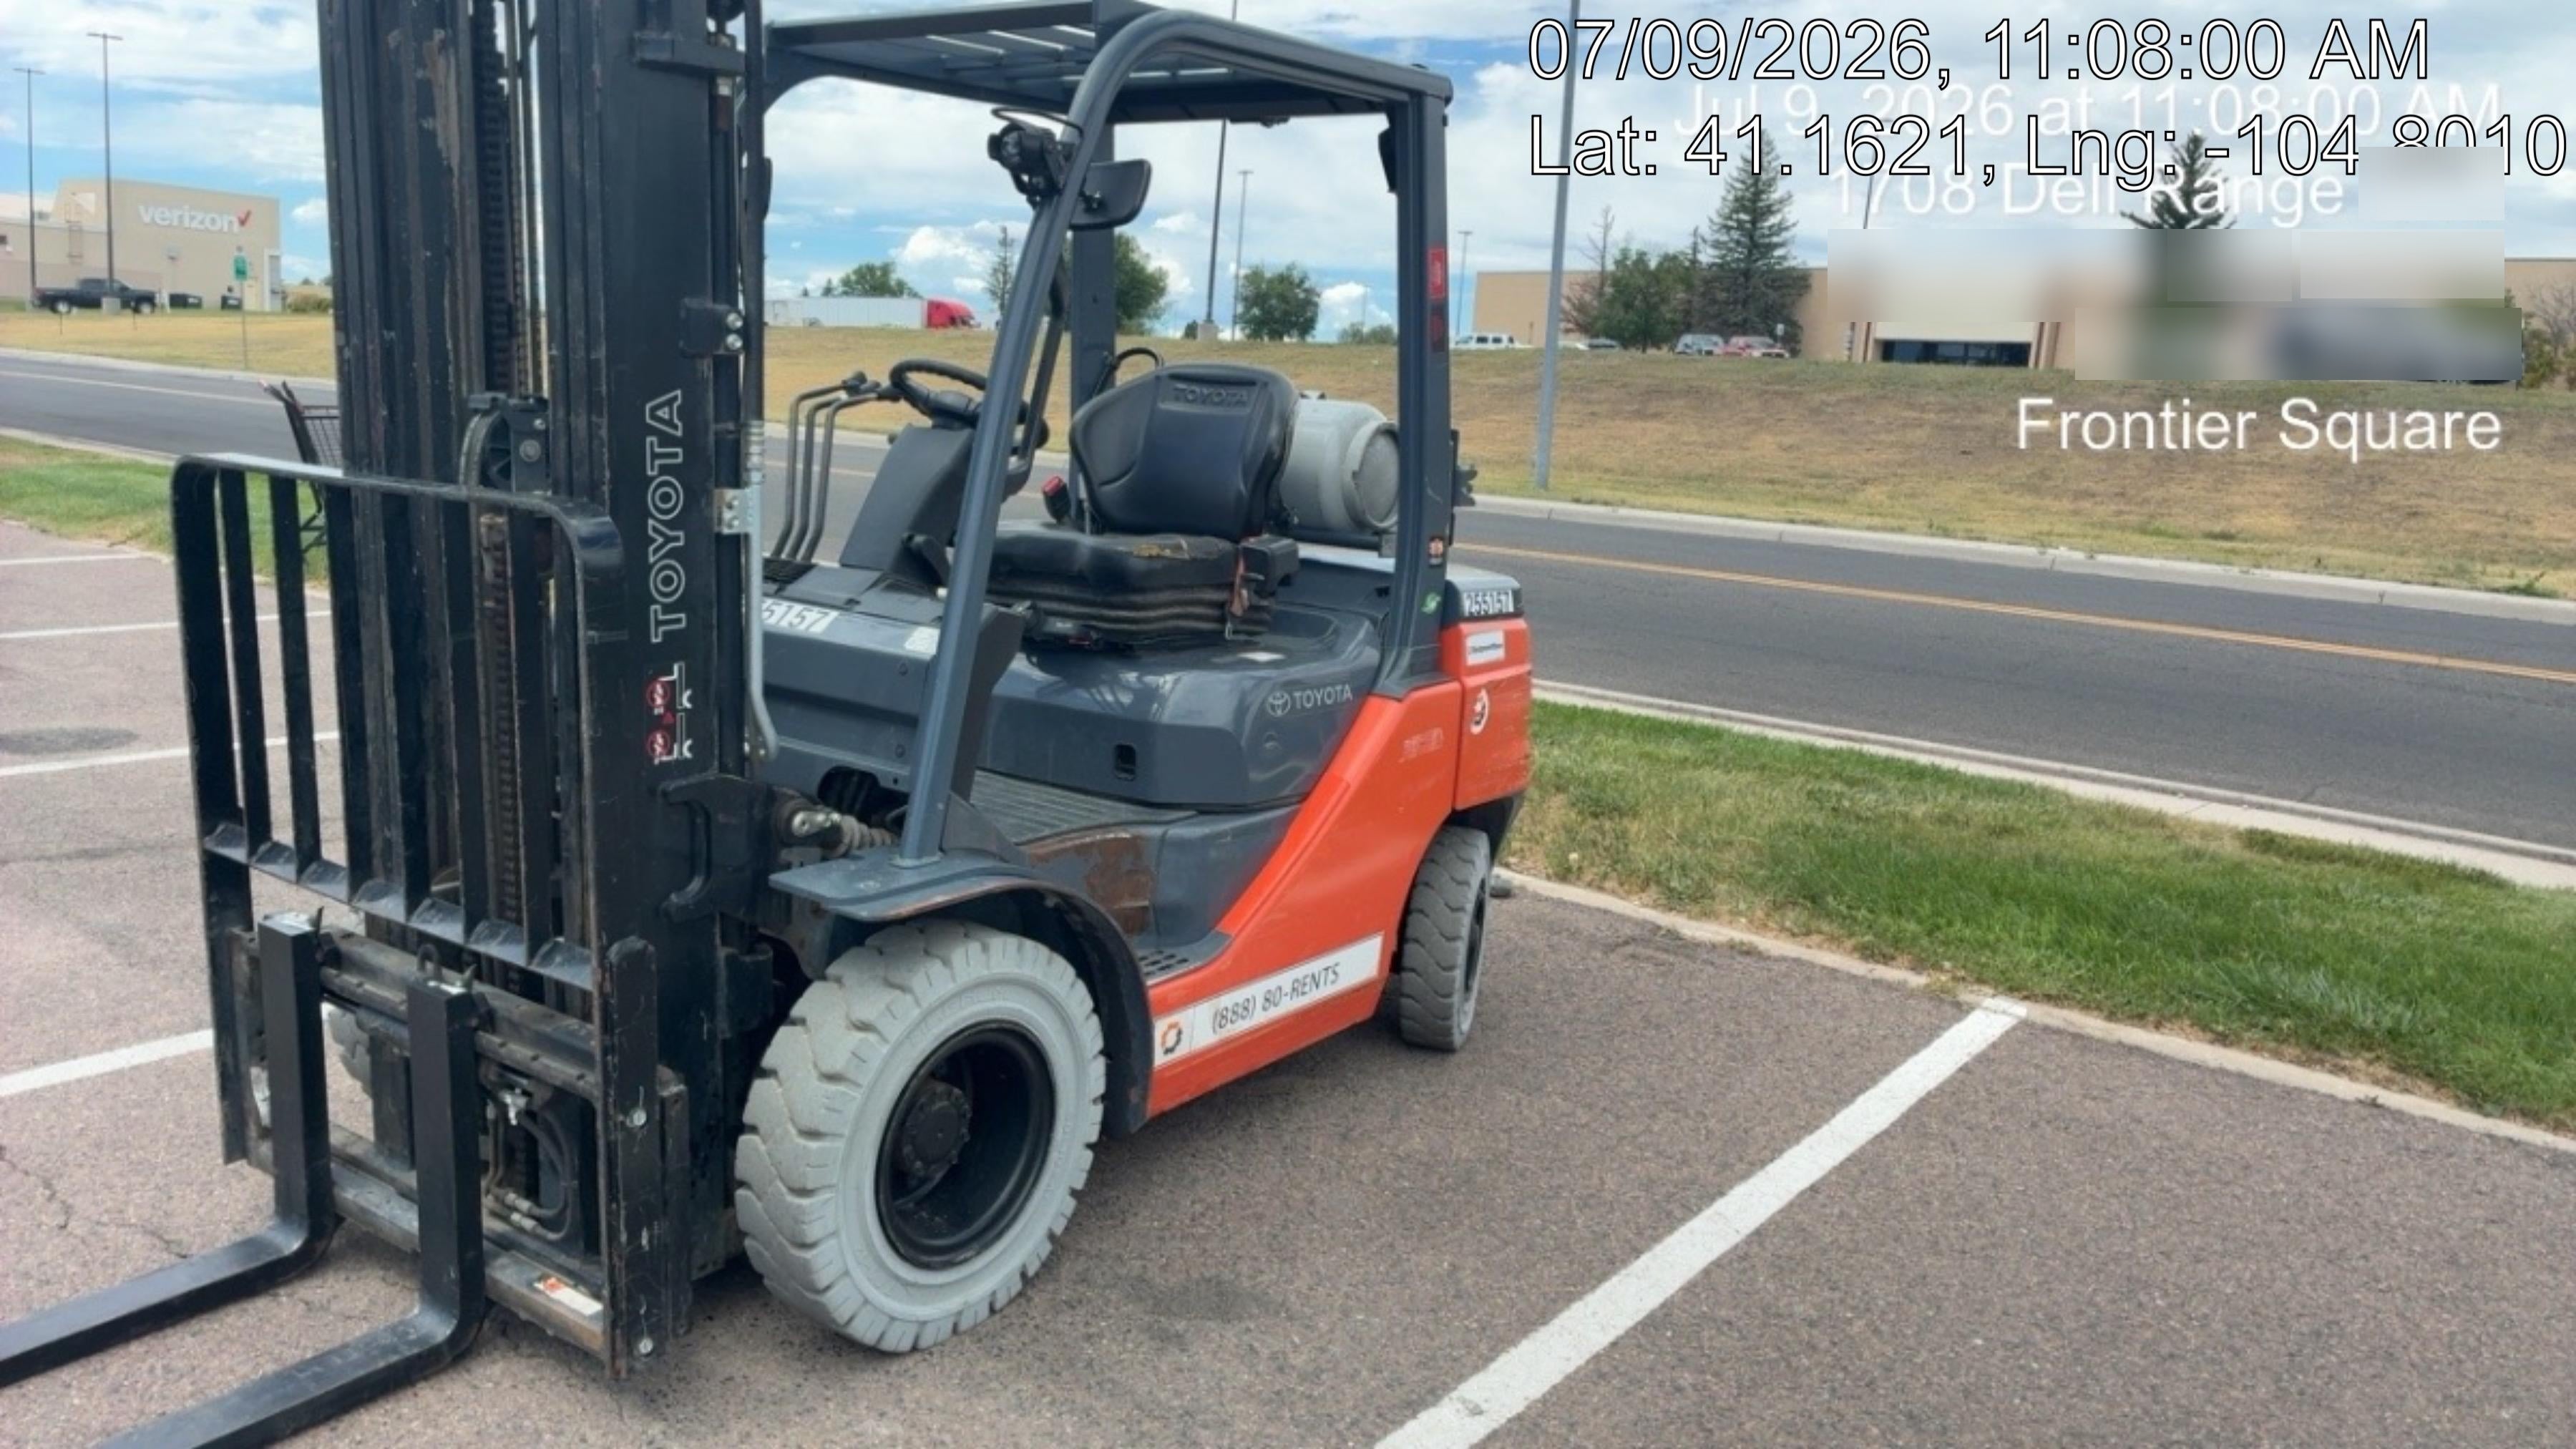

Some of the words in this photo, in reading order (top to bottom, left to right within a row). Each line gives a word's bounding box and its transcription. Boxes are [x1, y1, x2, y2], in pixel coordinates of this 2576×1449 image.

[137, 205, 240, 233] verizon
[645, 389, 686, 643] TOYOTA
[761, 600, 831, 631] 5157
[1293, 683, 1353, 710] TOYOTA
[1212, 994, 1257, 1035] (888)
[1261, 962, 1341, 1013] 80-RENTS
